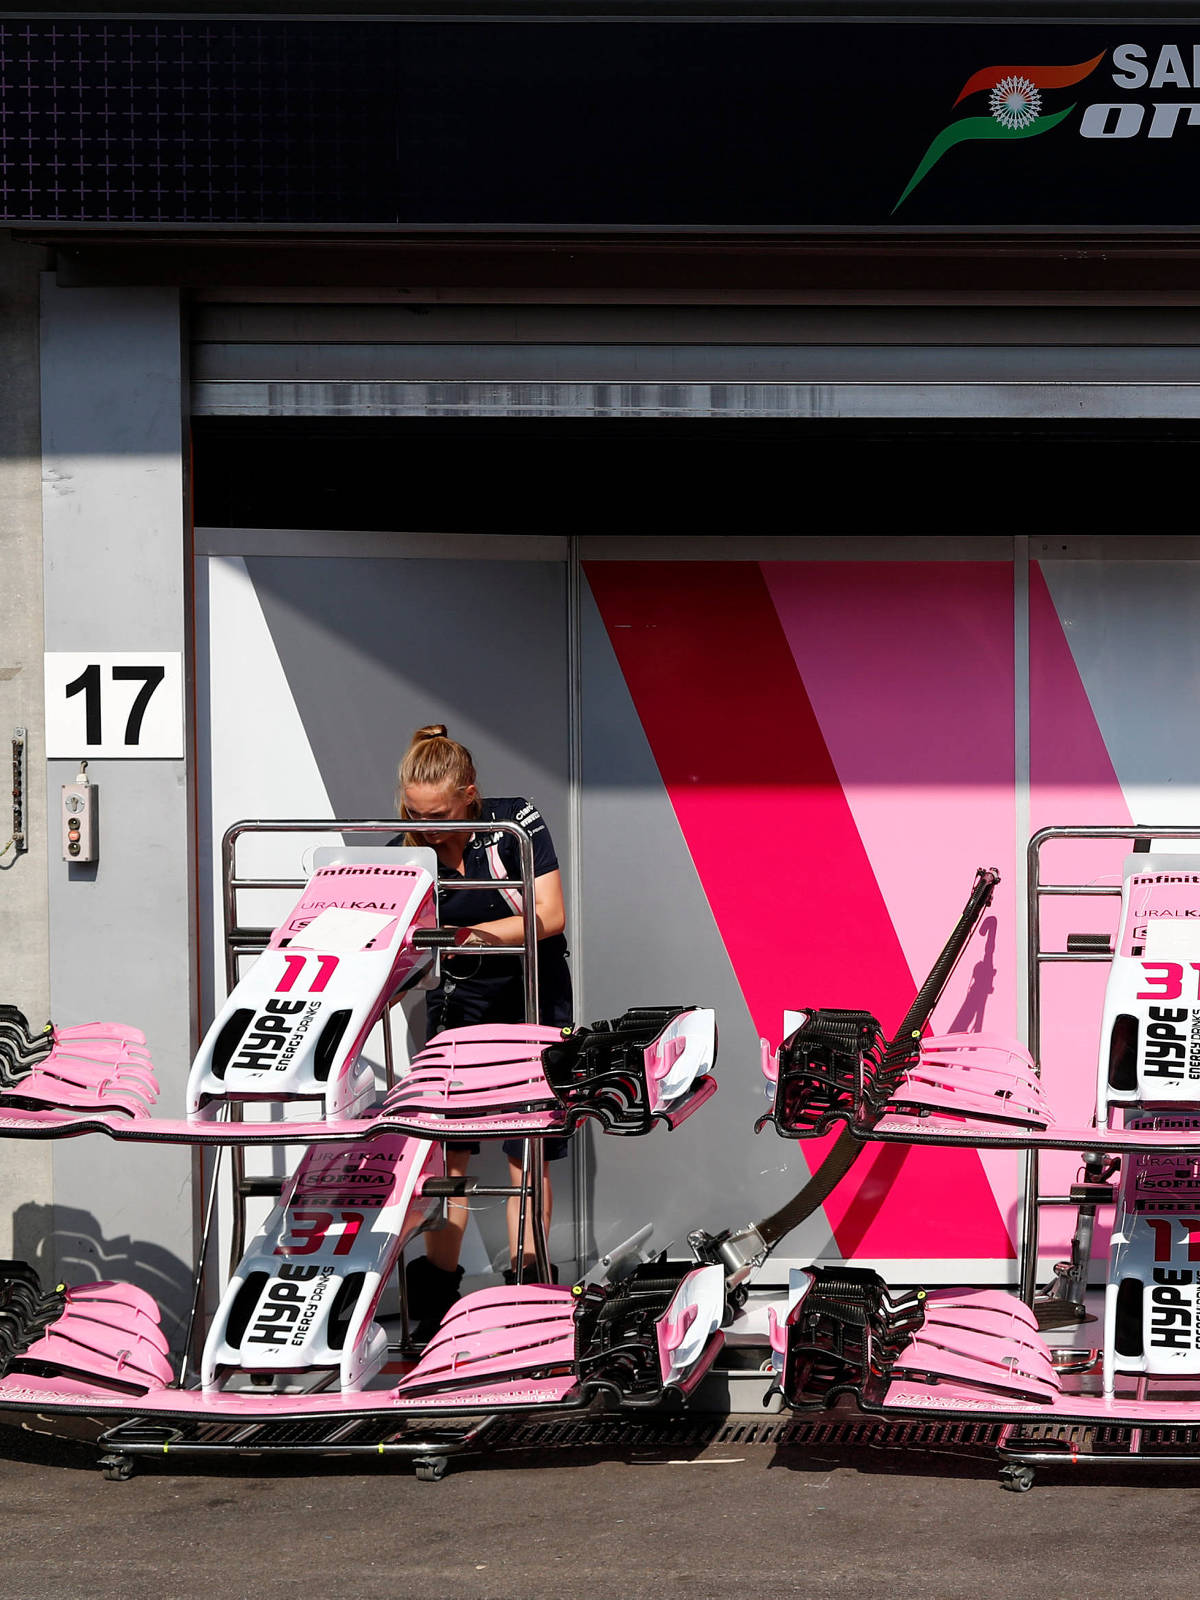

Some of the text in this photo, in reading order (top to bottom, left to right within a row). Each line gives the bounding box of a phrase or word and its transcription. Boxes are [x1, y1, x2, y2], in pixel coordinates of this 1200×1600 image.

[65, 664, 164, 746] 17
[316, 866, 418, 877] infinitum
[300, 901, 398, 910] URALKALI
[275, 955, 340, 993] 11
[275, 1000, 322, 1072] ENERGY DRINKS
[306, 1174, 387, 1184] SOFINA
[273, 1212, 364, 1255] 31
[291, 1266, 335, 1346] ENERGY DRINKS
